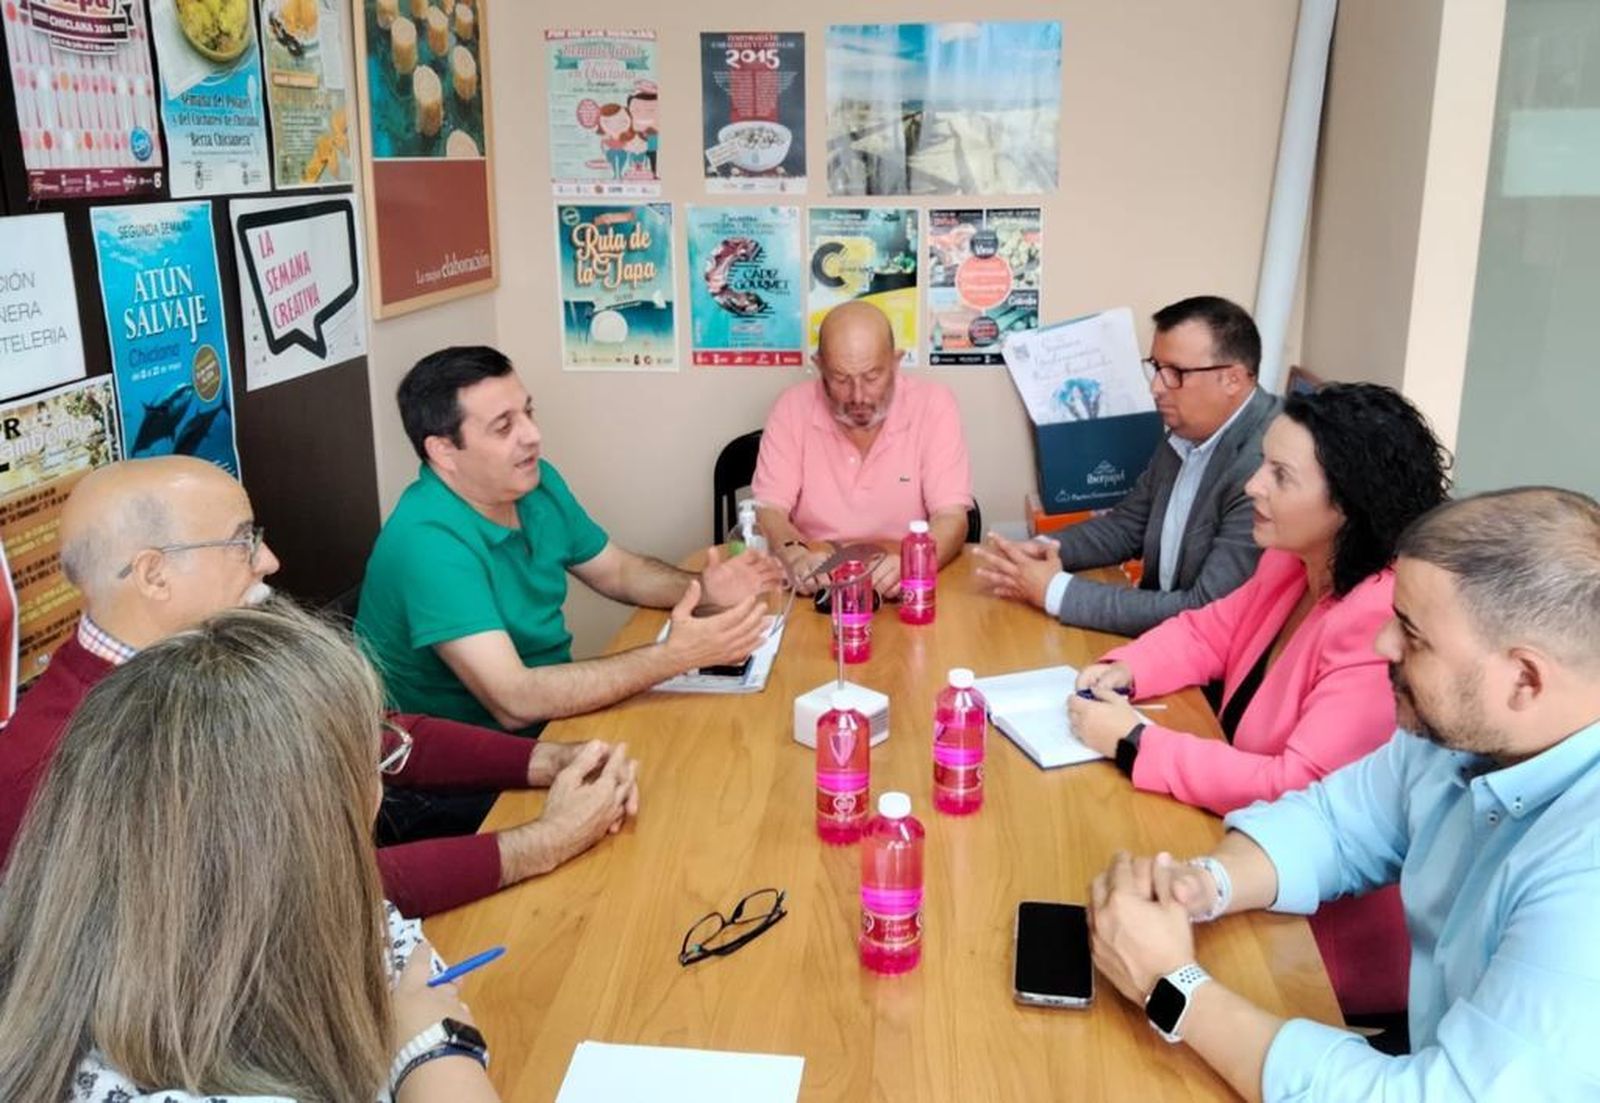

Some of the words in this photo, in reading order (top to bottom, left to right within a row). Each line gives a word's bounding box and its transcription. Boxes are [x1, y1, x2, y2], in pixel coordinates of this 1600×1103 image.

[725, 48, 780, 70] 2015
[117, 223, 159, 240] SEGUNDA
[258, 230, 274, 259] LA
[572, 222, 627, 260] Ruta
[630, 221, 652, 250] de
[134, 257, 194, 303] ATÚN
[265, 251, 312, 295] SEMANA
[577, 259, 596, 285] la
[593, 252, 656, 289] Tapa
[124, 295, 208, 343] SALVAJE
[272, 282, 320, 329] CREATIVA
